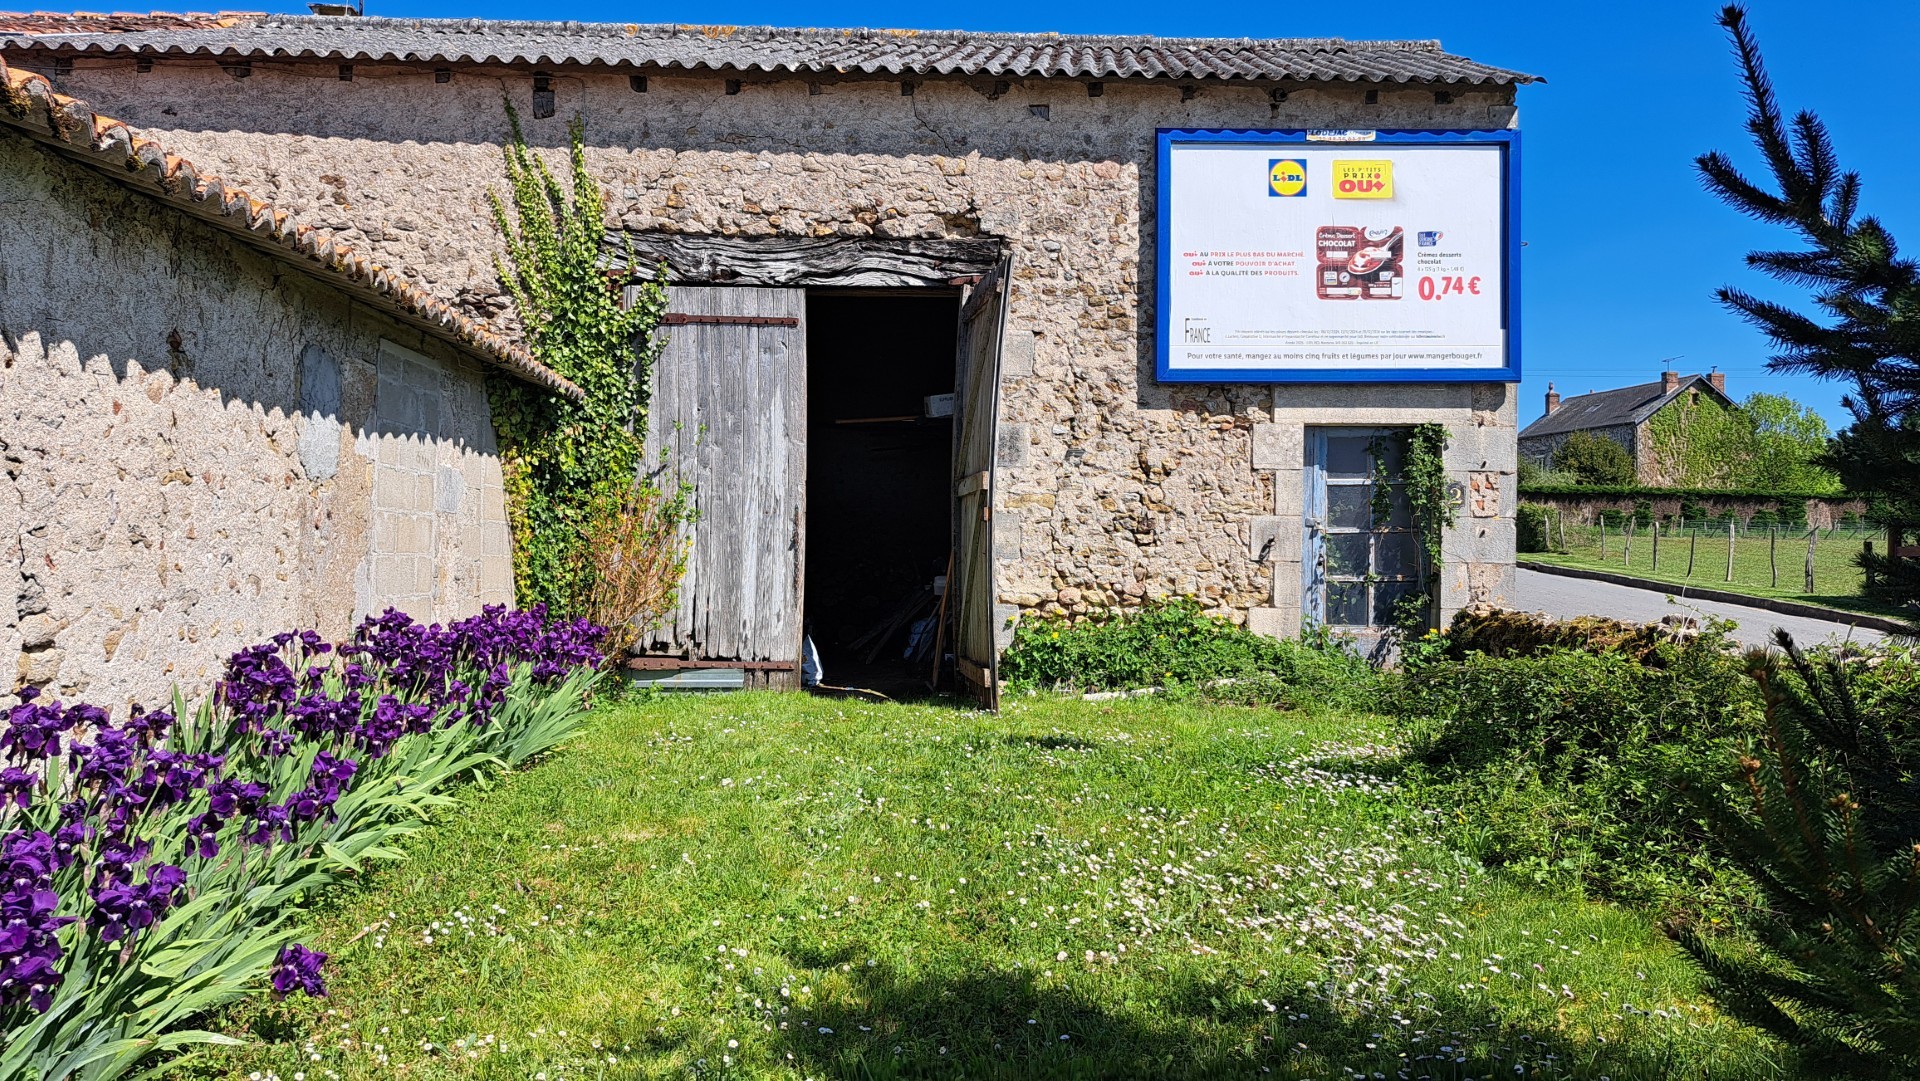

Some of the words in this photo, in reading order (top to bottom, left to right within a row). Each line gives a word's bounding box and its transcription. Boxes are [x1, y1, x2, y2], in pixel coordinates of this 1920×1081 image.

[1220, 269, 1249, 277] QUALITÉ
[1467, 276, 1481, 295] €
[1187, 352, 1203, 360] Pour
[1245, 353, 1272, 361] mangez
[1283, 352, 1304, 360] moins
[1305, 352, 1321, 361] cinq
[1321, 352, 1340, 360] fruits
[1341, 352, 1349, 360] et
[1350, 352, 1379, 361] légumes
[1380, 353, 1391, 361] par
[1392, 352, 1407, 361] jour
[1407, 352, 1483, 361] www.mangerbouger.fr
[1449, 487, 1462, 505] 2
